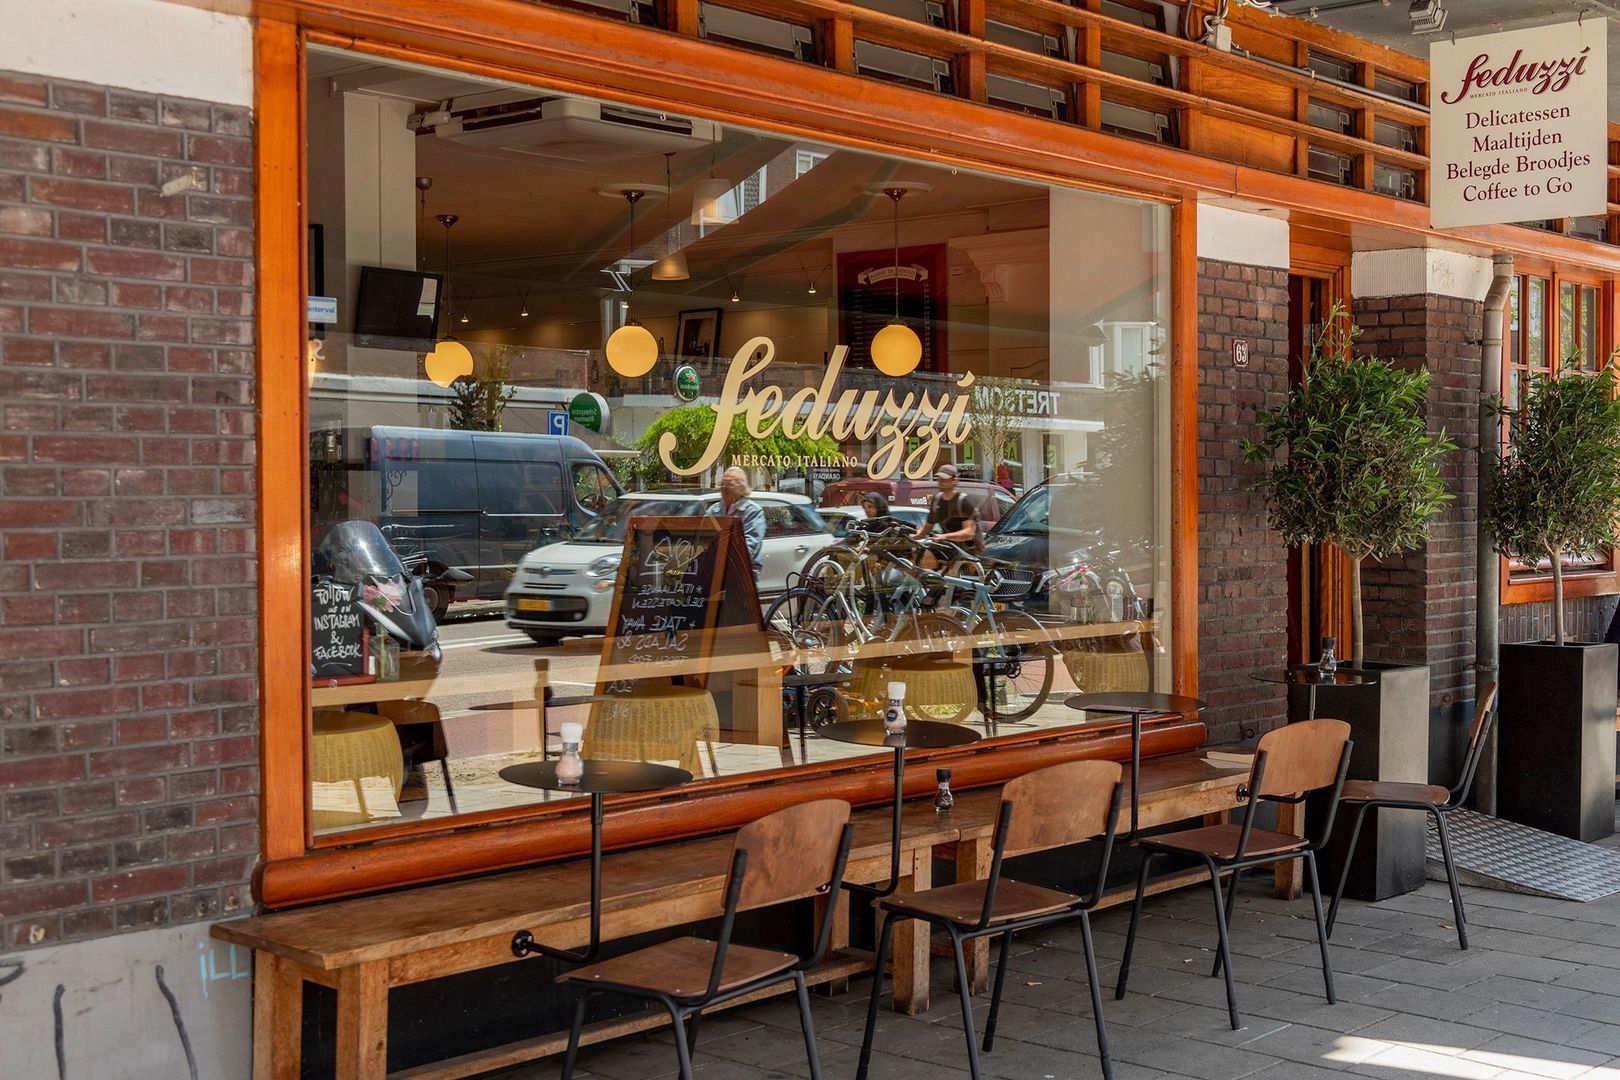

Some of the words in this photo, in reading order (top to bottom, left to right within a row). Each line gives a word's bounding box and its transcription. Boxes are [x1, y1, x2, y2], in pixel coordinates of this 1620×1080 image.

[1440, 46, 1591, 105] feduzzi
[1469, 91, 1497, 100] MERCATO
[1498, 87, 1528, 96] ITALIANO
[1465, 105, 1571, 130] Delicatessen
[1473, 129, 1563, 153] Maaltijden
[1446, 158, 1510, 180] Belegde
[1515, 150, 1591, 173] Broodjes
[1463, 181, 1518, 202] Coffee
[1524, 183, 1541, 197] to
[1546, 176, 1574, 194] Go
[1236, 343, 1247, 363] 63
[658, 336, 976, 480] feduzzi
[732, 454, 792, 469] MERCATO
[797, 454, 858, 469] ITALIANO
[314, 613, 361, 631] INSTAGRAM
[330, 630, 344, 645] &
[313, 643, 363, 660] FACEBOOK
